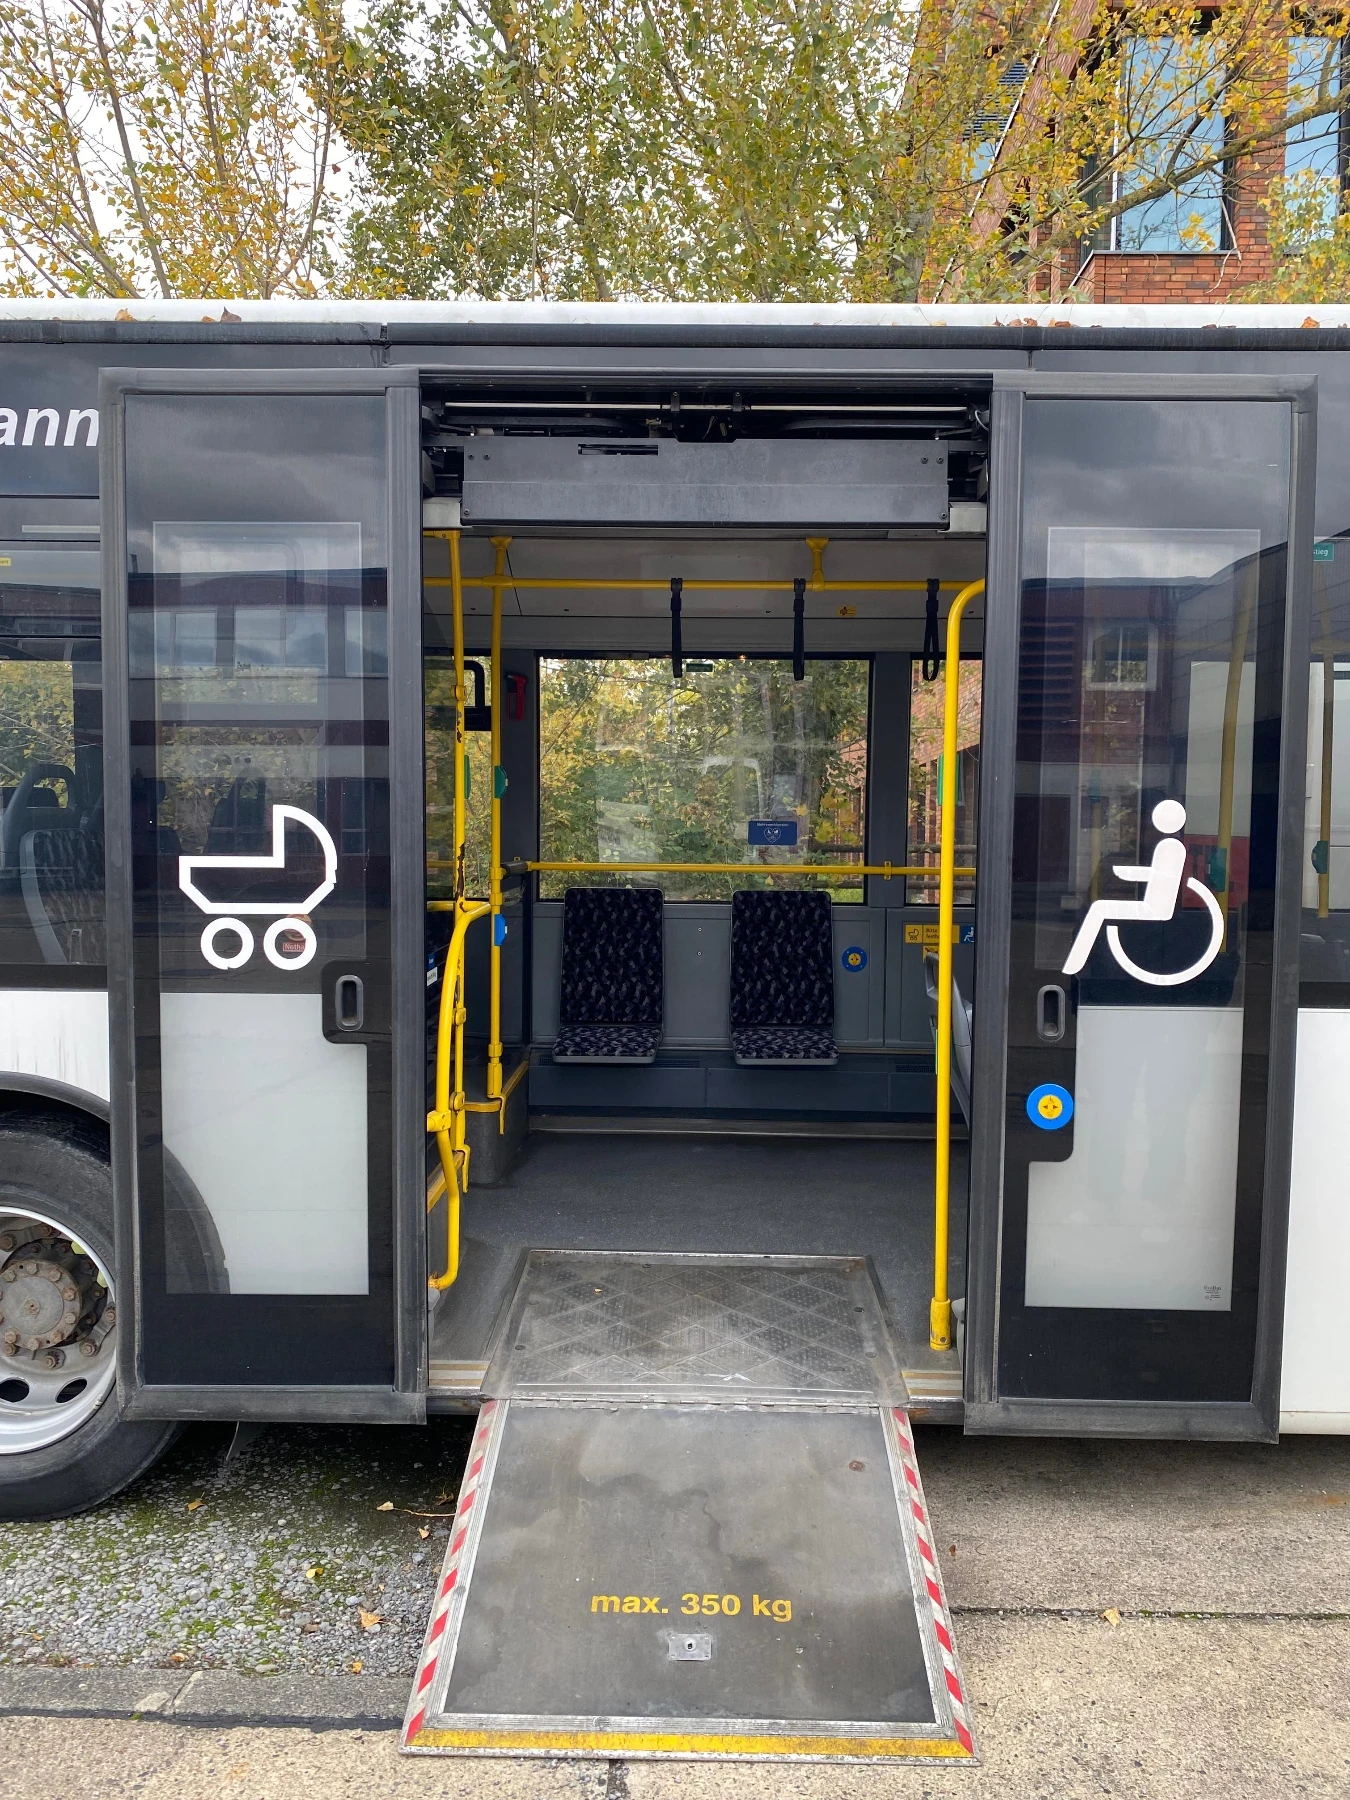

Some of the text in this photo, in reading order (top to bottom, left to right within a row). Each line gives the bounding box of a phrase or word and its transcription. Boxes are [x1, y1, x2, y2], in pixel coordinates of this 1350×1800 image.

[590, 1593, 793, 1623] max. 350 kg
